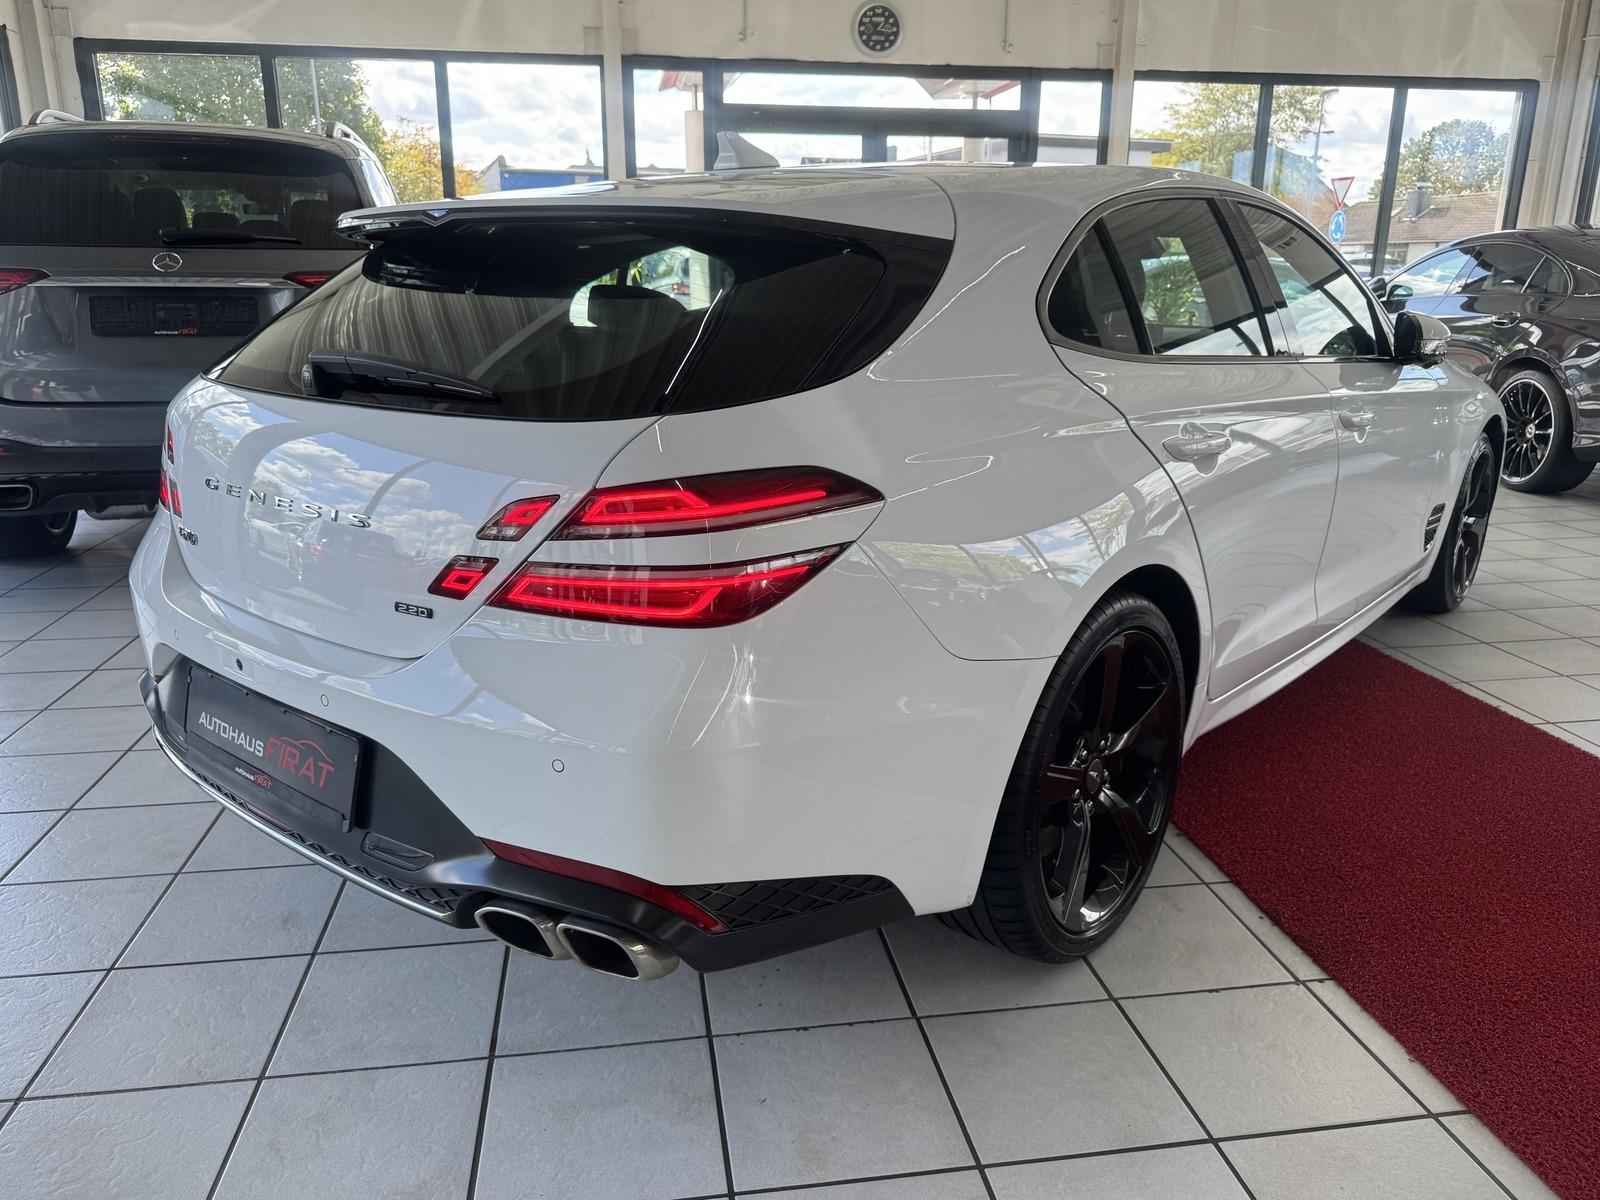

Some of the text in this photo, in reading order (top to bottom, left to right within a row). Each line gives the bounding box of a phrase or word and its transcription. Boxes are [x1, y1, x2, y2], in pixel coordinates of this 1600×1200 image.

[204, 477, 372, 528] GENESIS
[198, 711, 335, 789] AUTOHAUS FIRAT
